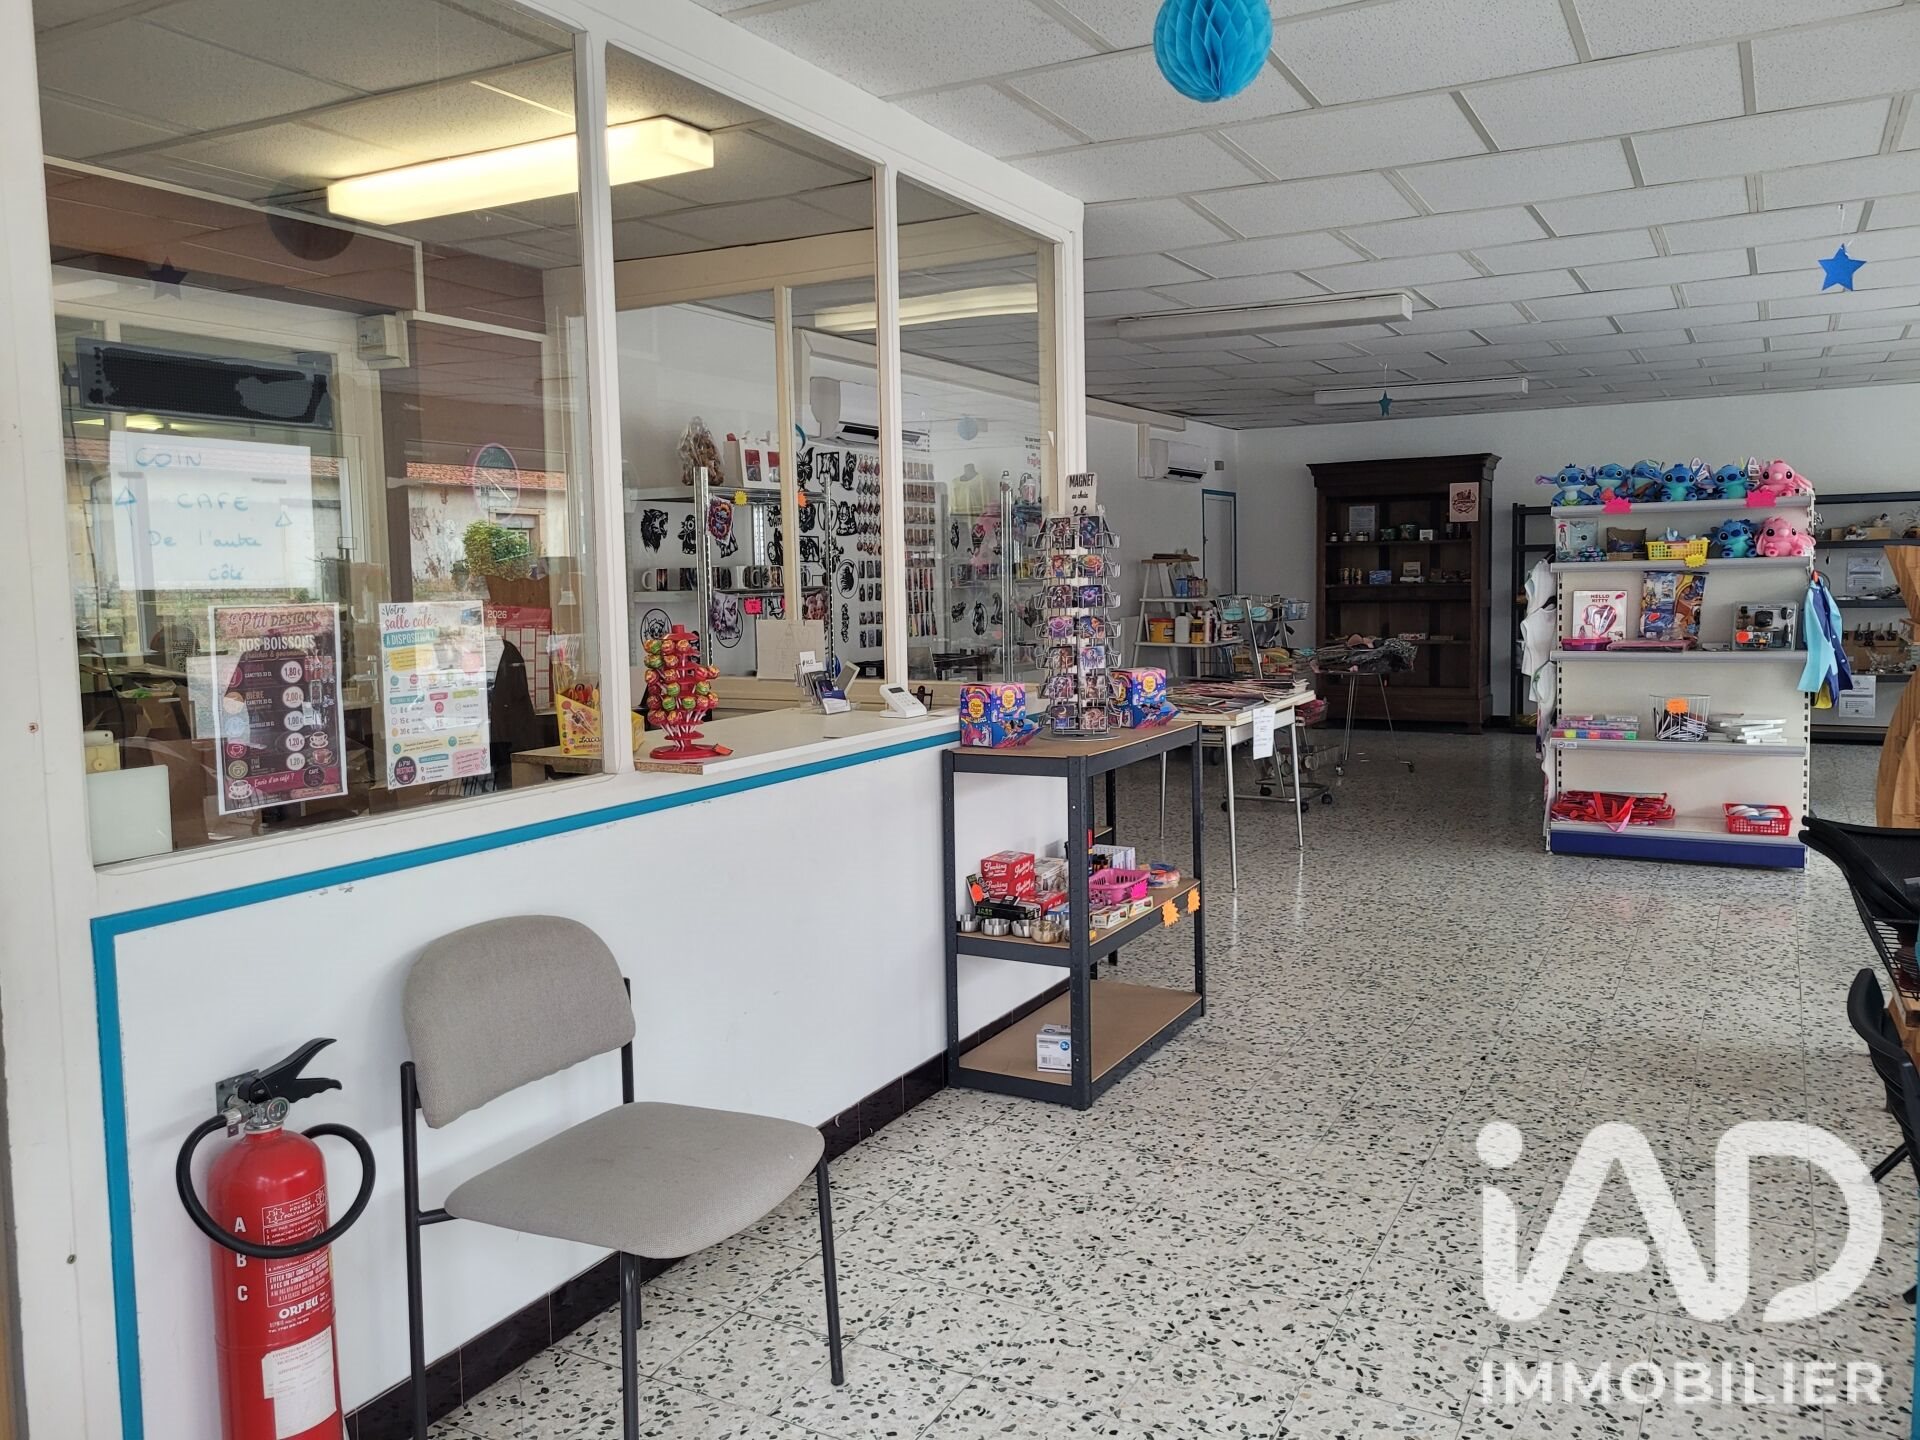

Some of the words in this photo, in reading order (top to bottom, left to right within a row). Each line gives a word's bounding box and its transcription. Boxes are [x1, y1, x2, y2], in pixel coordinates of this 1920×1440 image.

[136, 447, 202, 467] COIN
[1069, 473, 1095, 488] MAGNET
[148, 530, 177, 547] De
[385, 604, 407, 616] Votre
[487, 610, 508, 619] 2026
[270, 610, 319, 627] DESTOCK
[385, 614, 410, 631] salle
[413, 613, 433, 628] café
[240, 637, 261, 652] NOS
[263, 635, 316, 651] BOISSONS
[984, 861, 1007, 873] Smoking
[985, 880, 1008, 891] Smoking
[234, 1216, 246, 1233] A
[236, 1253, 247, 1268] B
[237, 1285, 248, 1301] C
